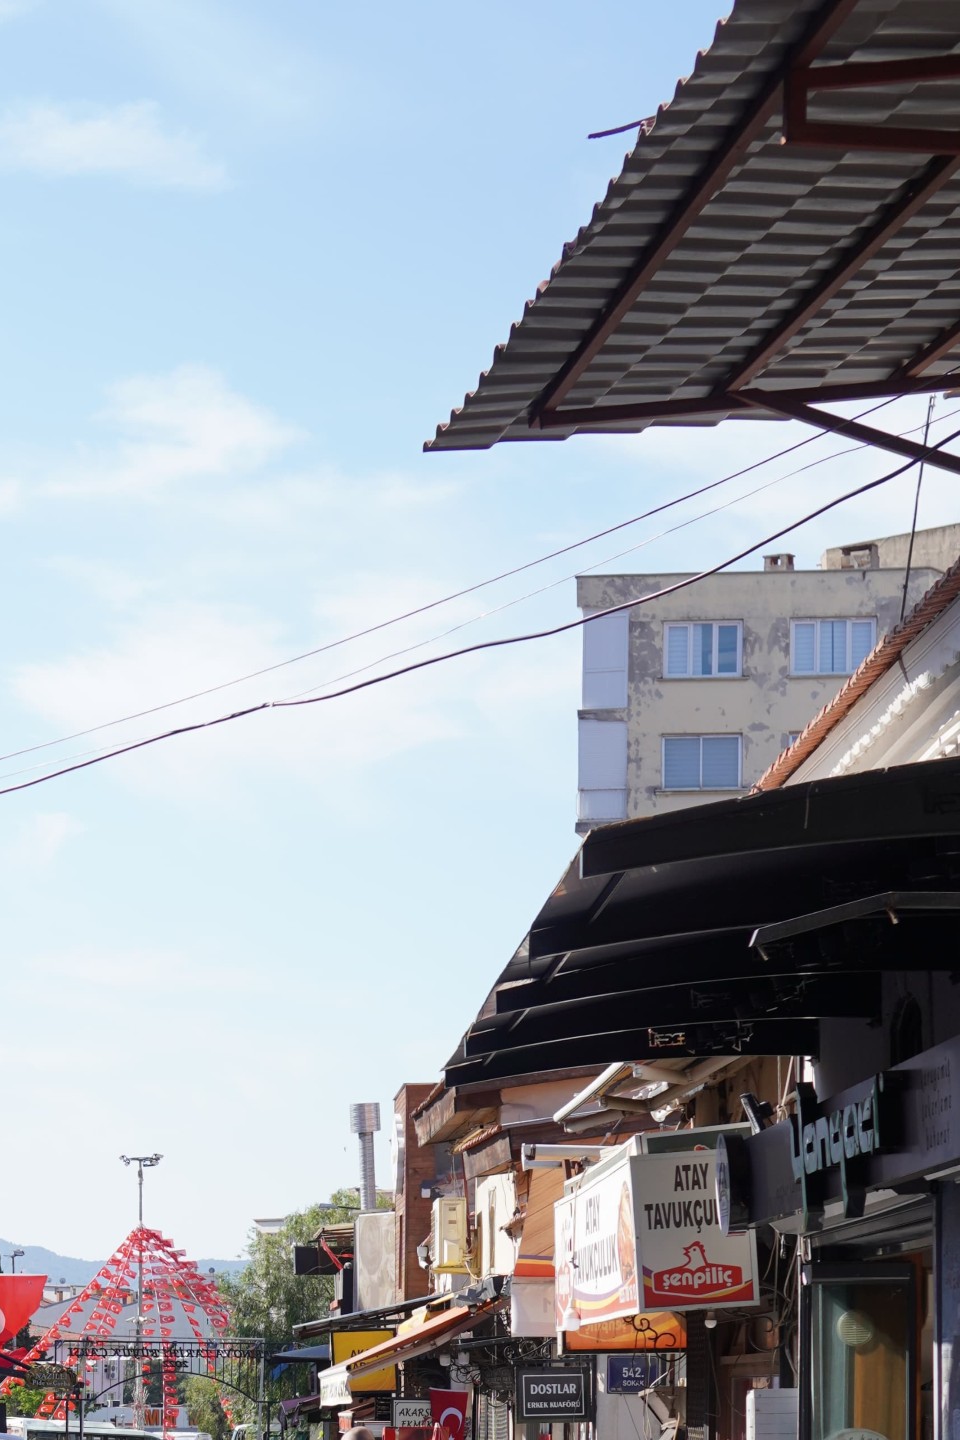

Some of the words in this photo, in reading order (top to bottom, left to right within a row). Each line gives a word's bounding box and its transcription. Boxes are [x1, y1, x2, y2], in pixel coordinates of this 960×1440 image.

[674, 1163, 709, 1192] ATAY
[585, 1193, 601, 1236] ATAY
[622, 1367, 645, 1378] 542.
[530, 1383, 577, 1395] DOSTLAR
[527, 1401, 549, 1409] ERKEK
